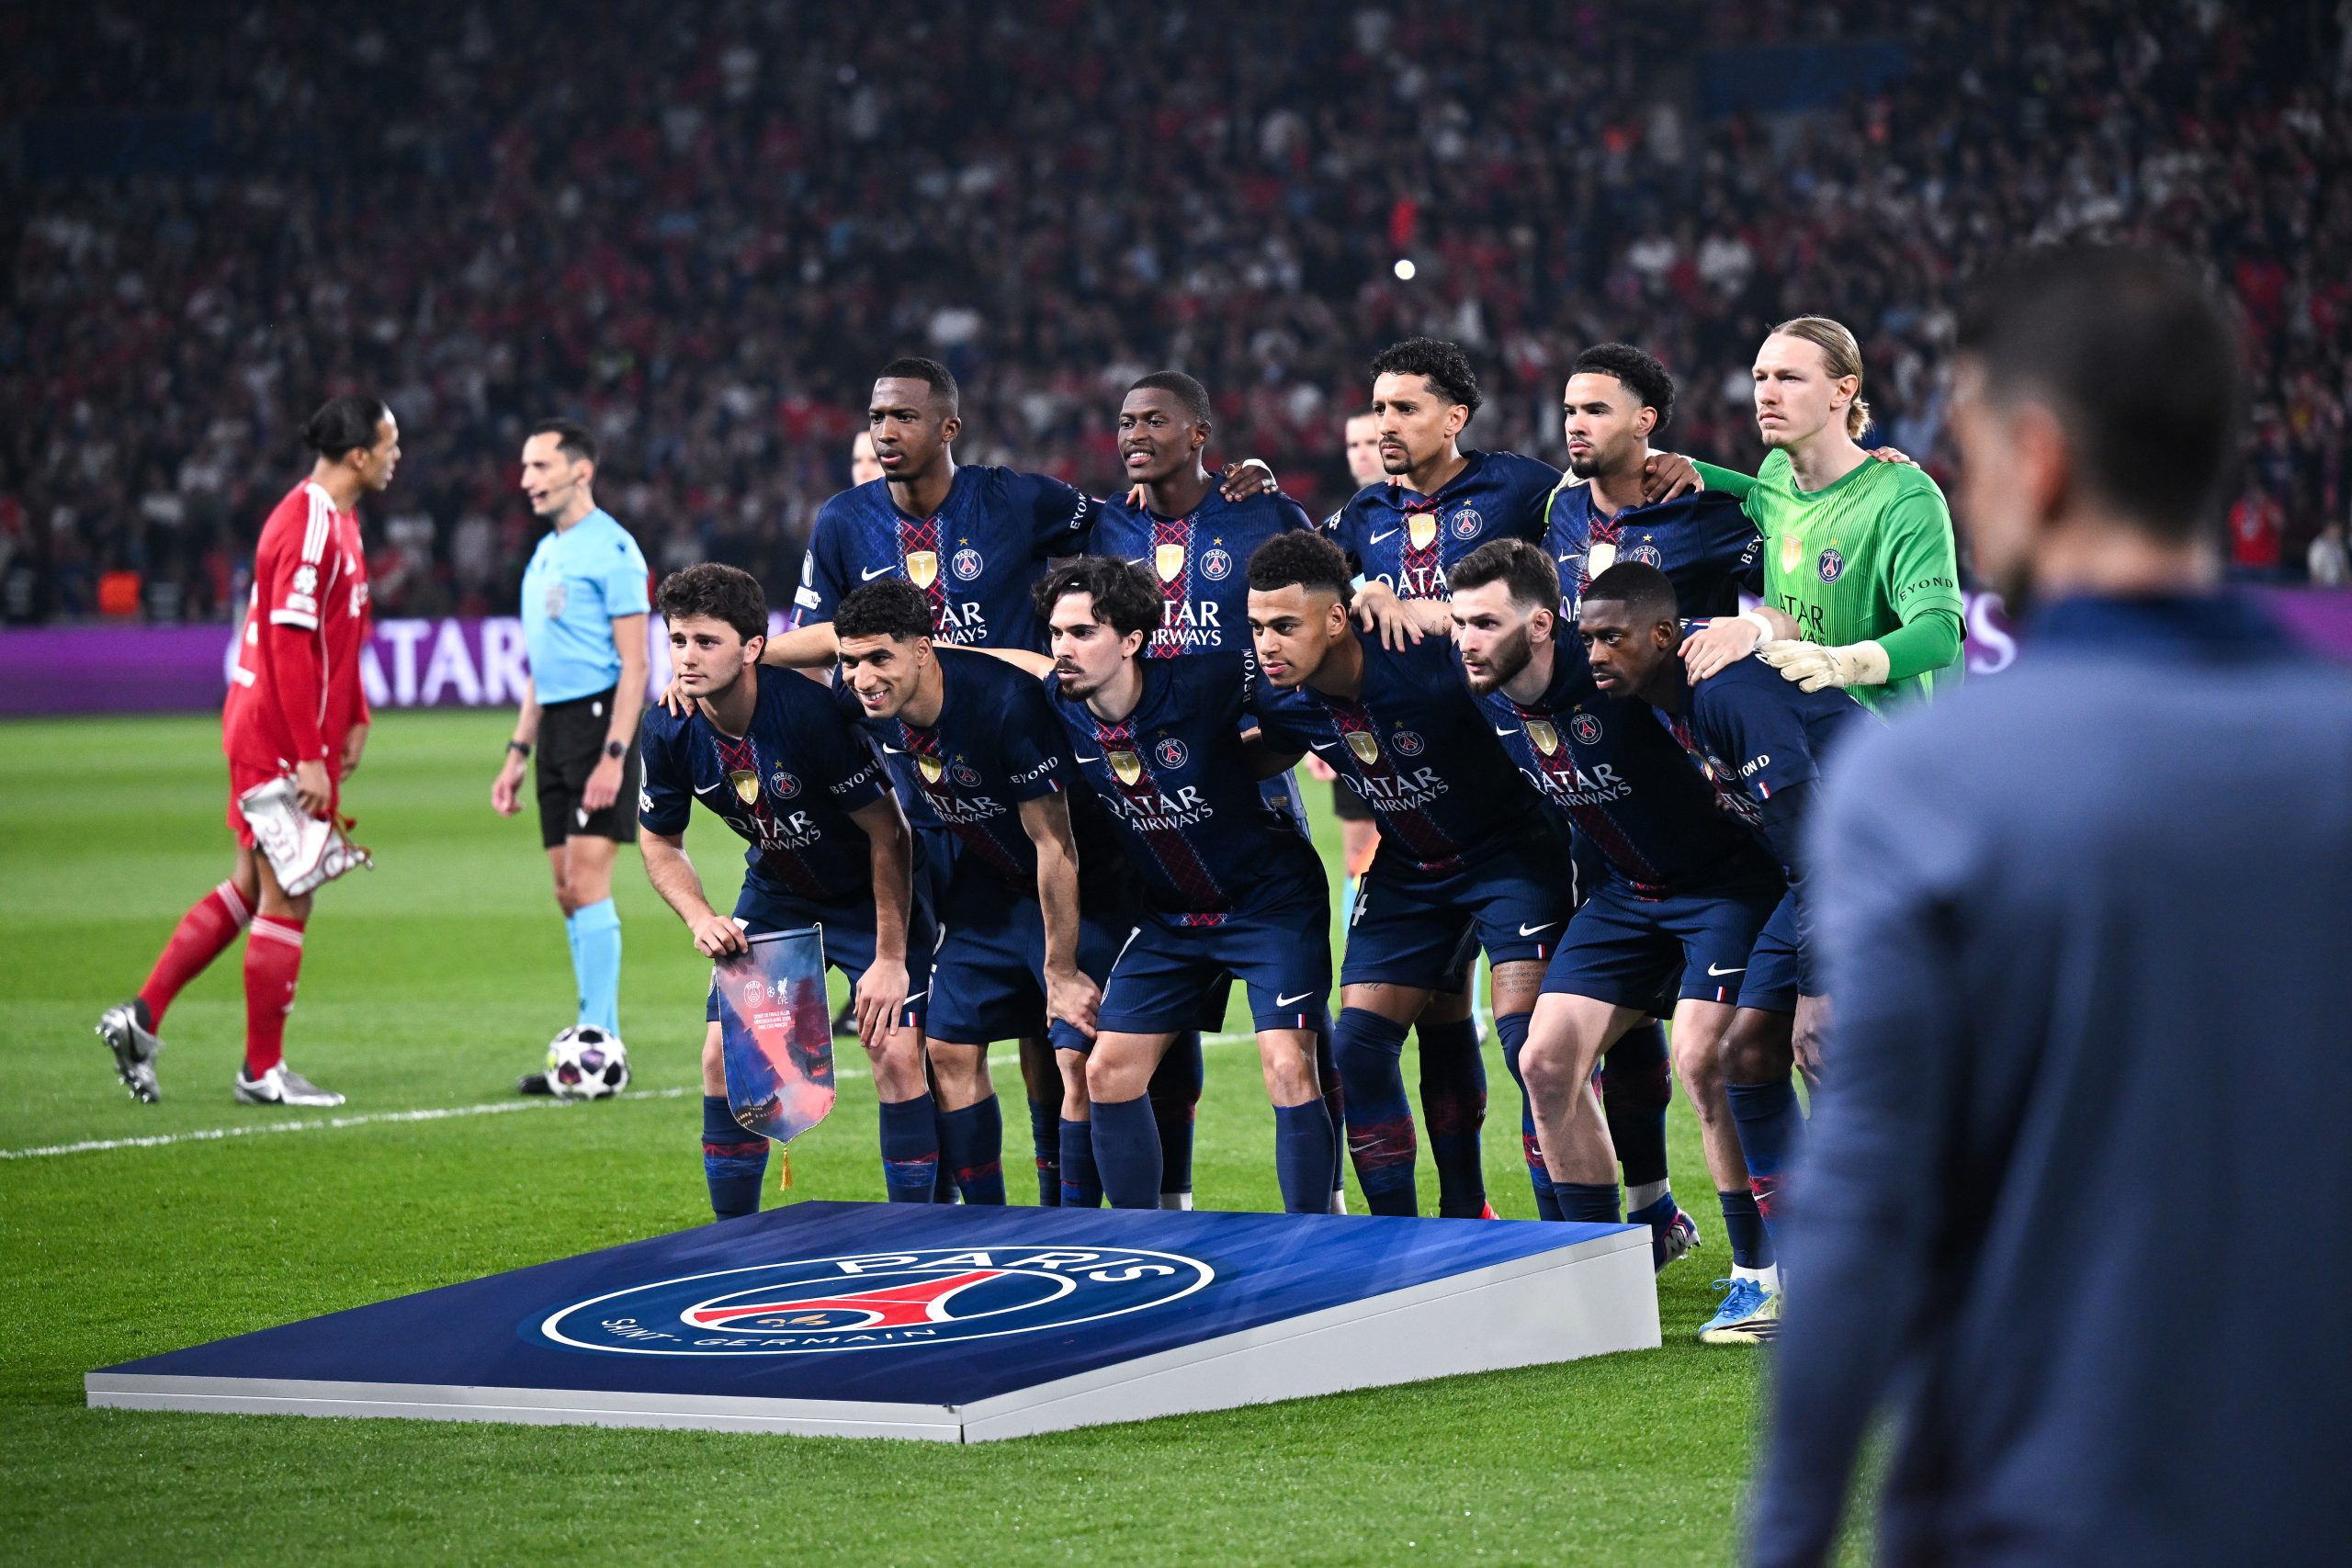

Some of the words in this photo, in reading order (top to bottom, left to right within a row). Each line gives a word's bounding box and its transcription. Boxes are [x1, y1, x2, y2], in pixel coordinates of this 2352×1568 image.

[1455, 510, 1476, 520] PARIS
[956, 548, 977, 560] PARIS
[1206, 550, 1227, 559] PARIS
[1635, 546, 1657, 556] PARIS
[1740, 534, 1764, 565] BEY
[1899, 576, 1954, 602] EYOND
[1163, 600, 1221, 627] TAR
[1780, 592, 1825, 635] ATAR
[1149, 629, 1222, 646] IRWAYS
[1341, 766, 1442, 800] QATAR
[1519, 762, 1623, 795] QATAR
[922, 790, 1000, 814] ATAR
[1098, 785, 1205, 820] QATAR
[1373, 780, 1449, 812] AIRWAYS
[1553, 781, 1633, 807] AIRWAYS
[1132, 802, 1214, 831] AIRWAYS
[835, 1251, 1176, 1282] PARIS
